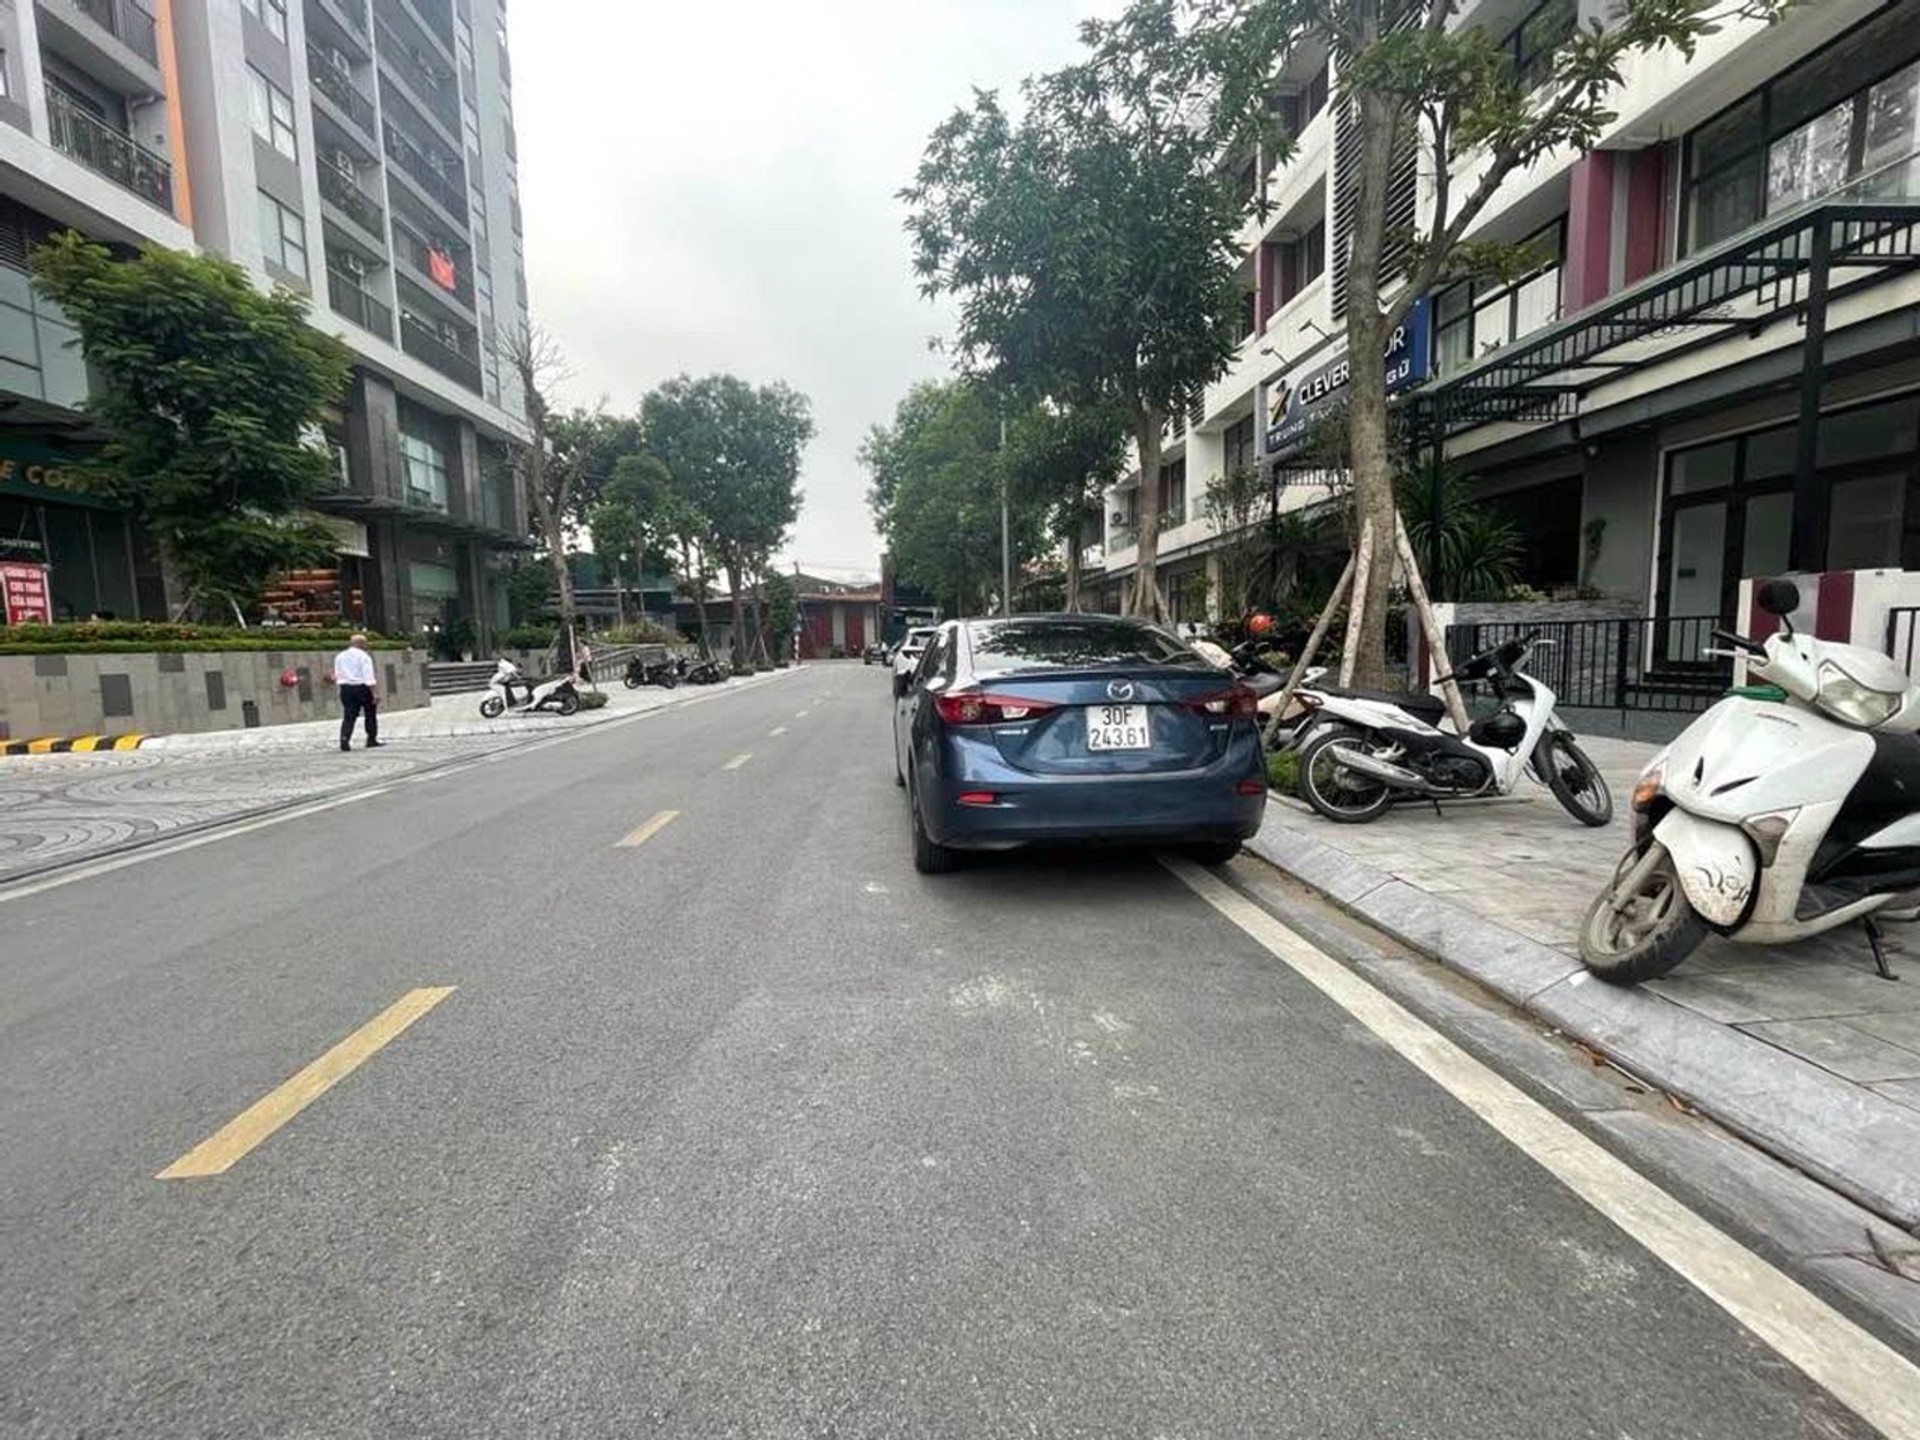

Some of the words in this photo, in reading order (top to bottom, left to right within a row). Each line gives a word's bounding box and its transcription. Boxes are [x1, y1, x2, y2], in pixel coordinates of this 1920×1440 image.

[1300, 360, 1350, 405] CLEVER
[1102, 706, 1133, 726] 30F
[1091, 728, 1148, 748] 243.61
